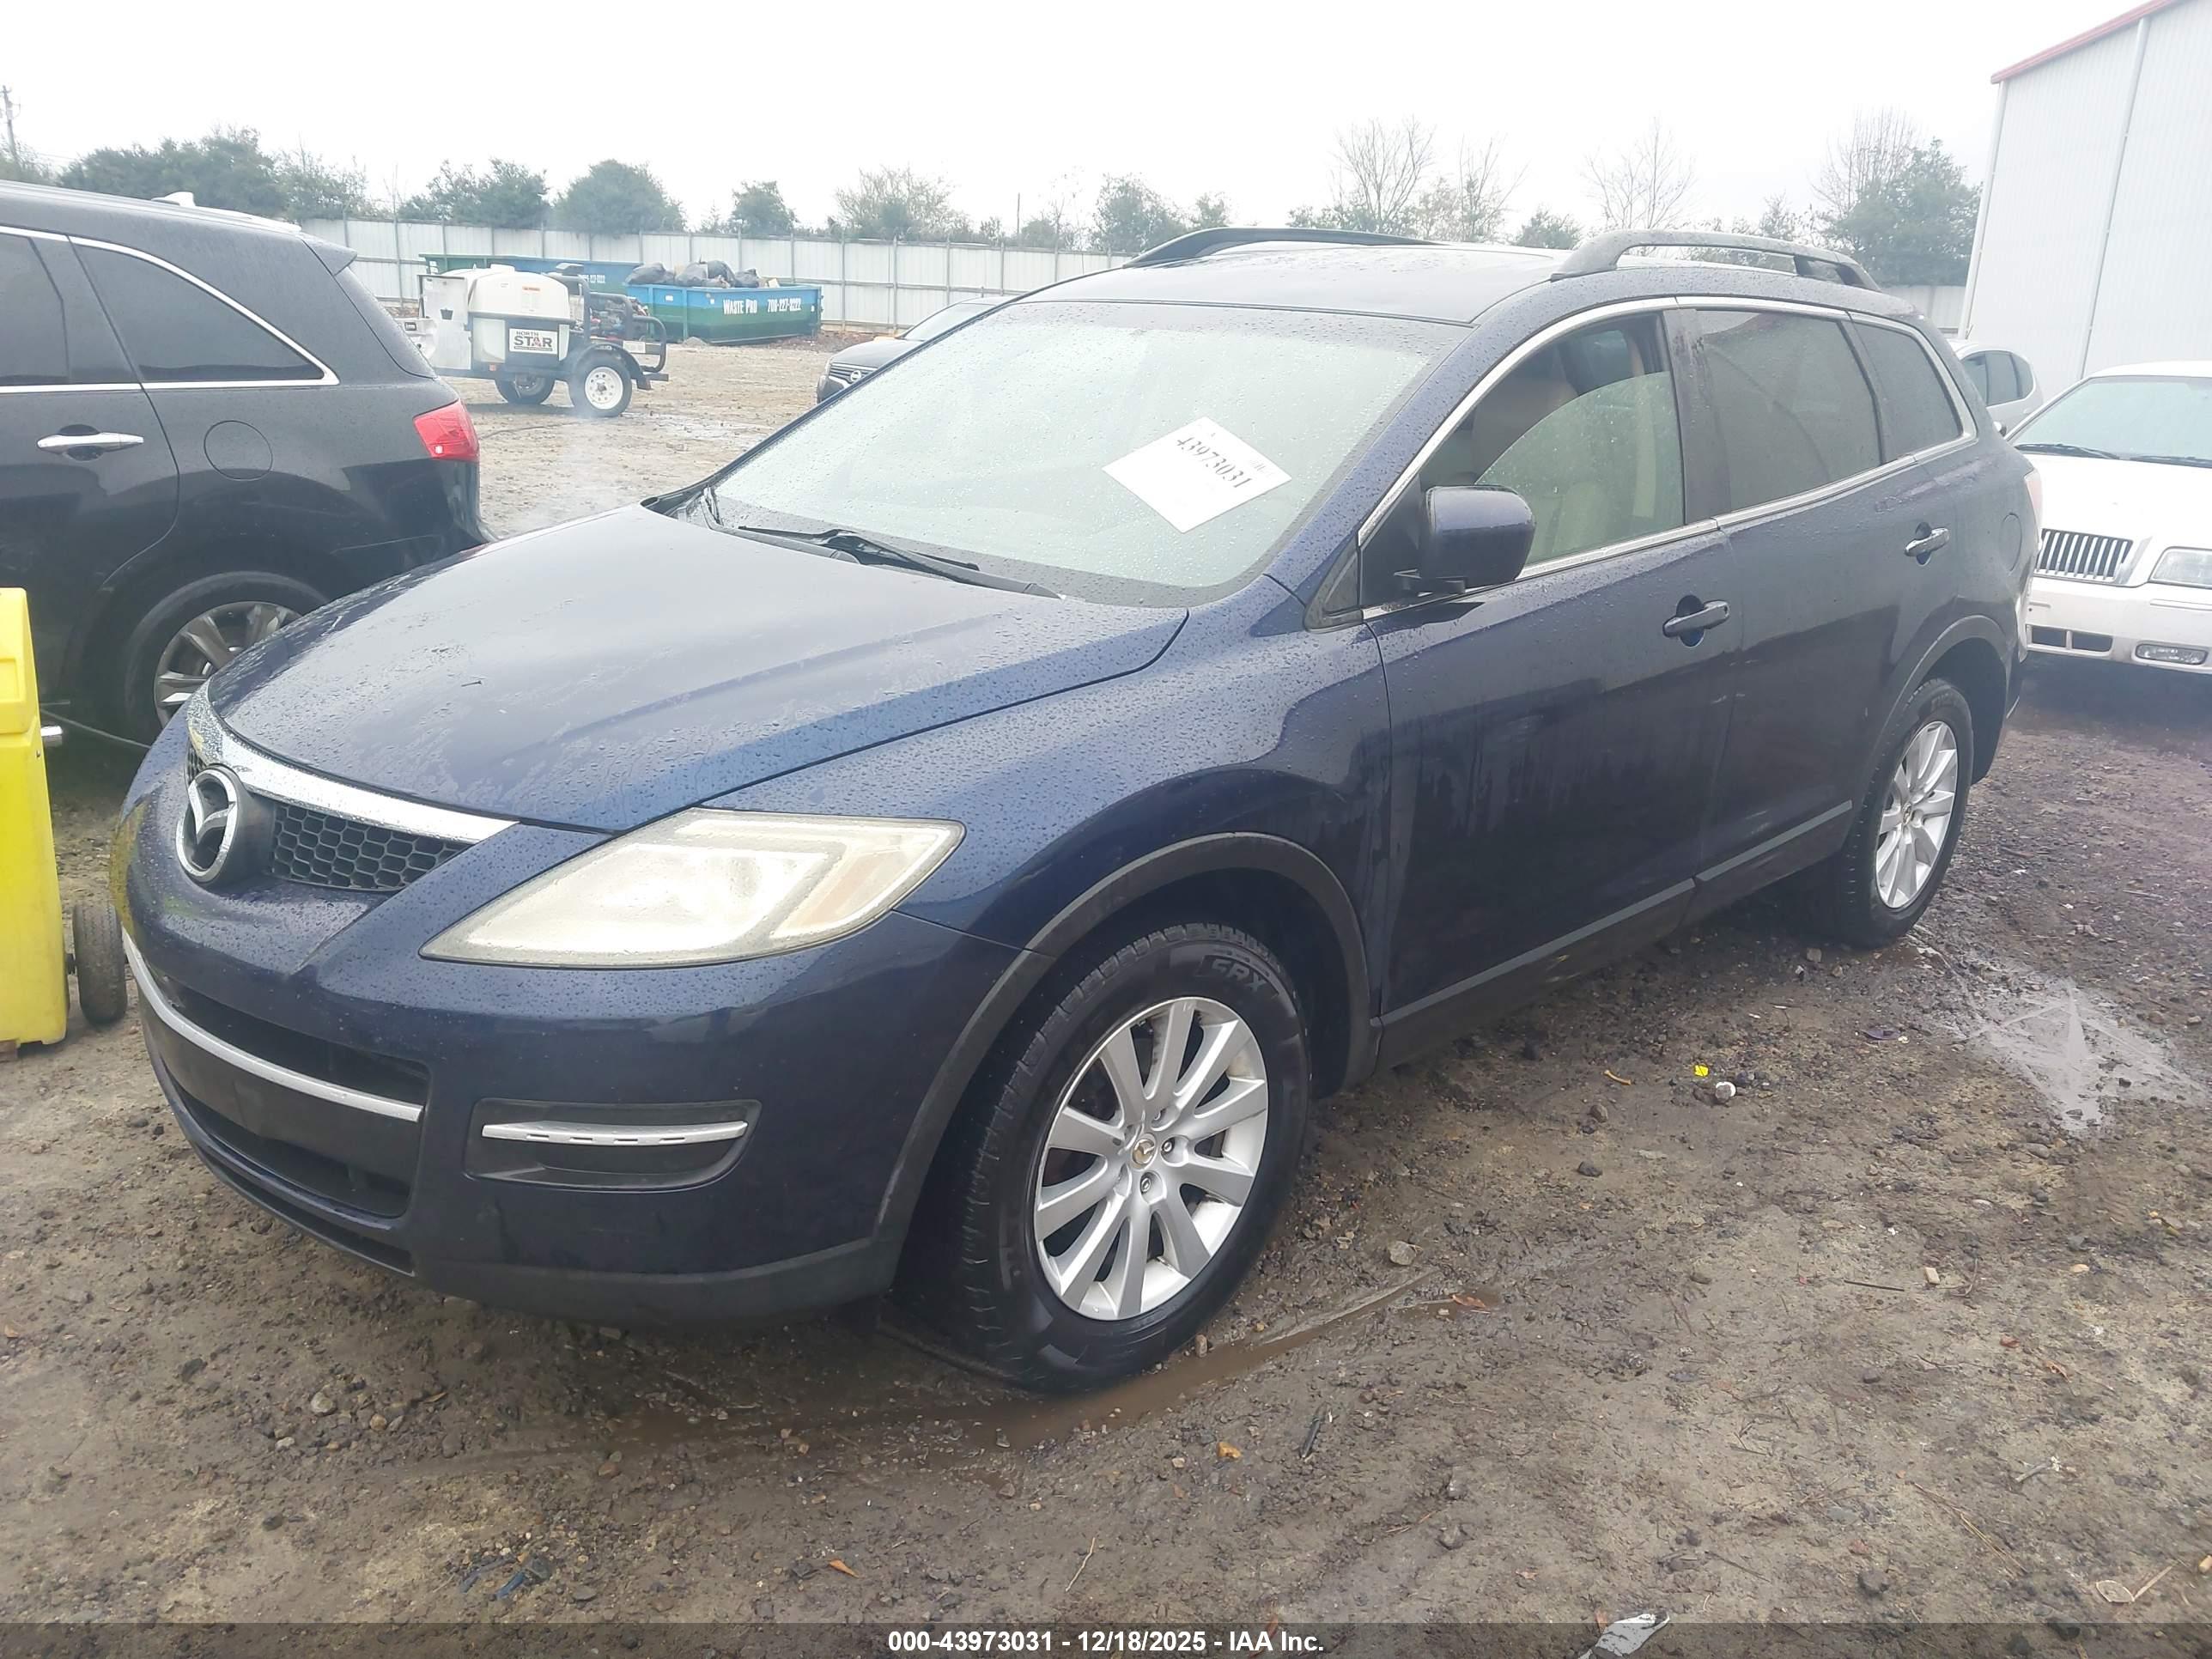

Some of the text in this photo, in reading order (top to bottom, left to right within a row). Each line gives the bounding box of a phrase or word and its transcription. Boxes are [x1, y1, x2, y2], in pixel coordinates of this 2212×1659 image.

[723, 299, 744, 314] WASTE
[745, 299, 757, 314] PRO
[514, 336, 552, 347] STAR
[1176, 437, 1252, 488] 43973031
